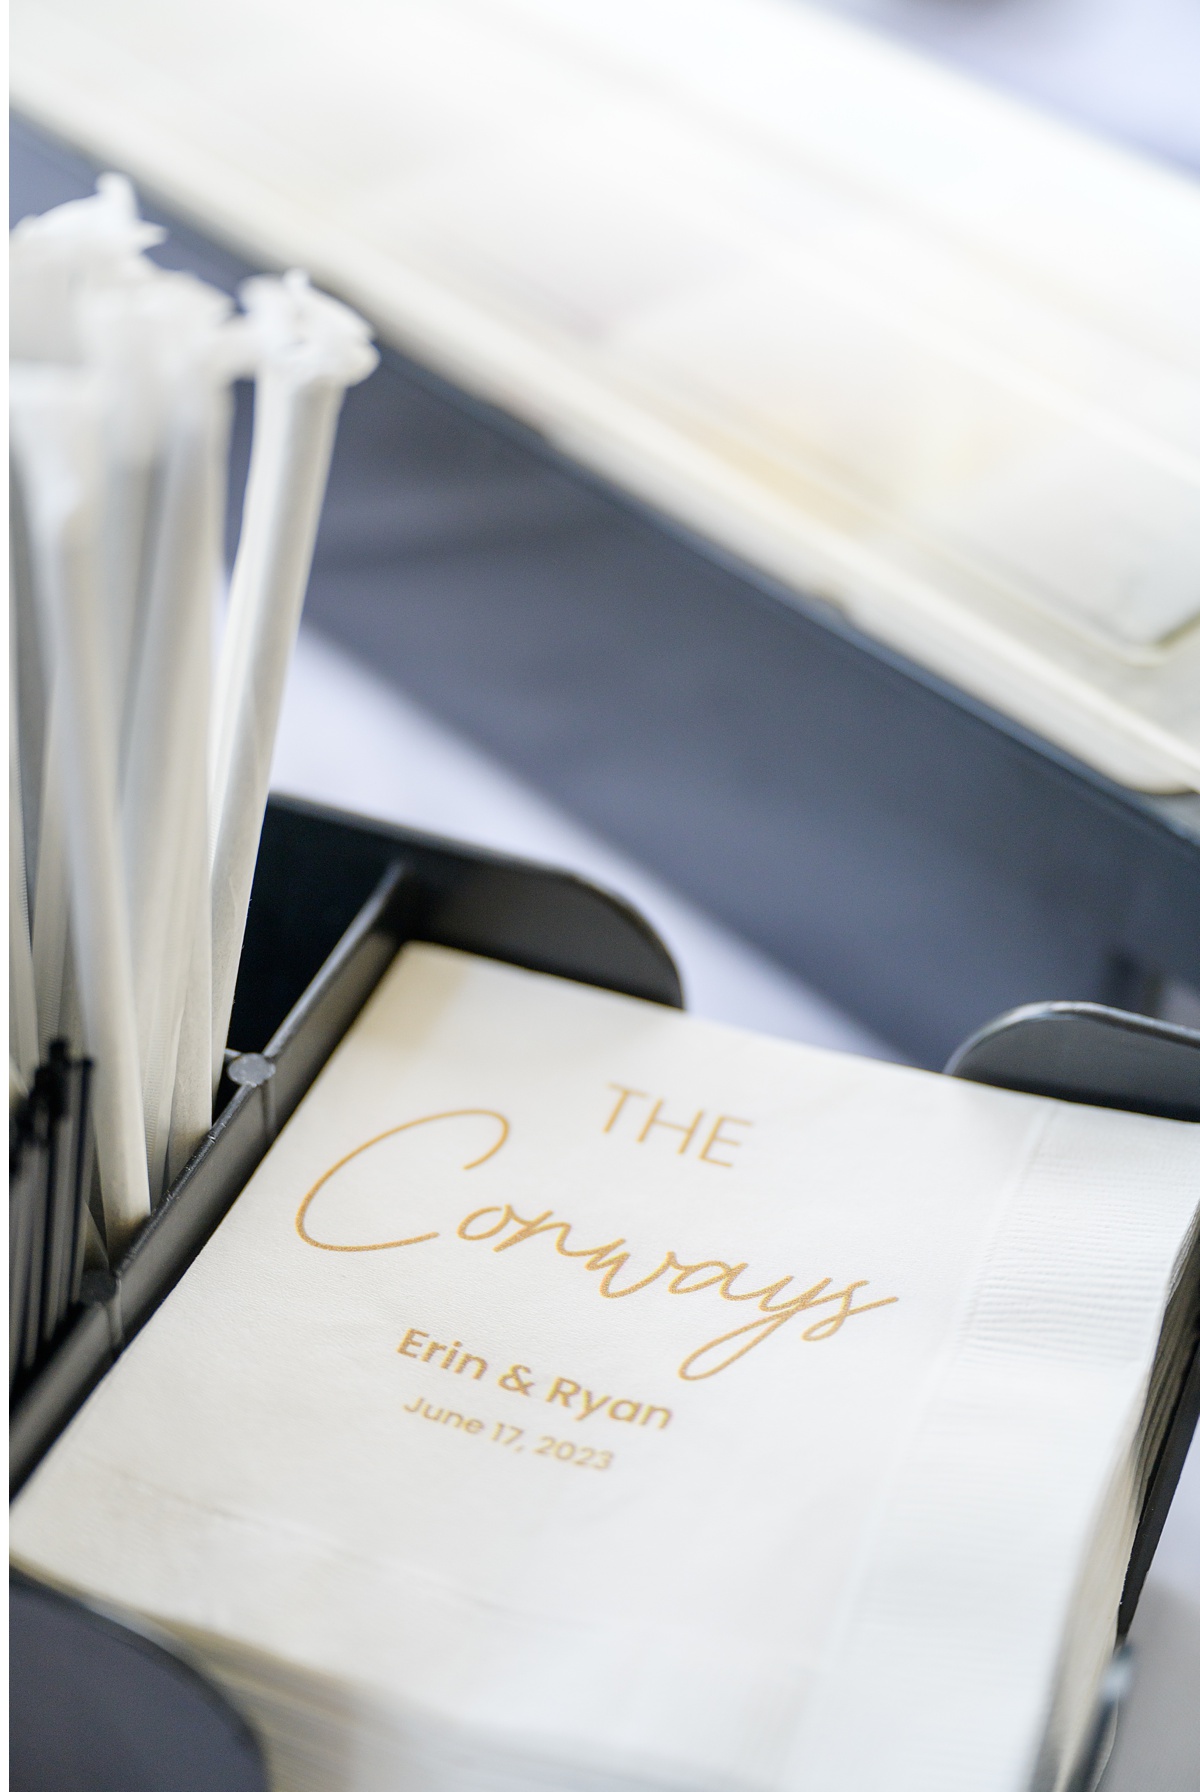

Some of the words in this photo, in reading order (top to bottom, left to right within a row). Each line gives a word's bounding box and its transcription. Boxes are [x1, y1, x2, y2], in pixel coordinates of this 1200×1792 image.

[601, 1082, 754, 1169] THE
[294, 1108, 899, 1382] Conways
[395, 1327, 489, 1381] Erin
[496, 1363, 535, 1397] &
[544, 1375, 674, 1430] Ryan
[402, 1396, 485, 1435] June
[490, 1421, 526, 1454] 17,
[532, 1435, 616, 1472] 2023
